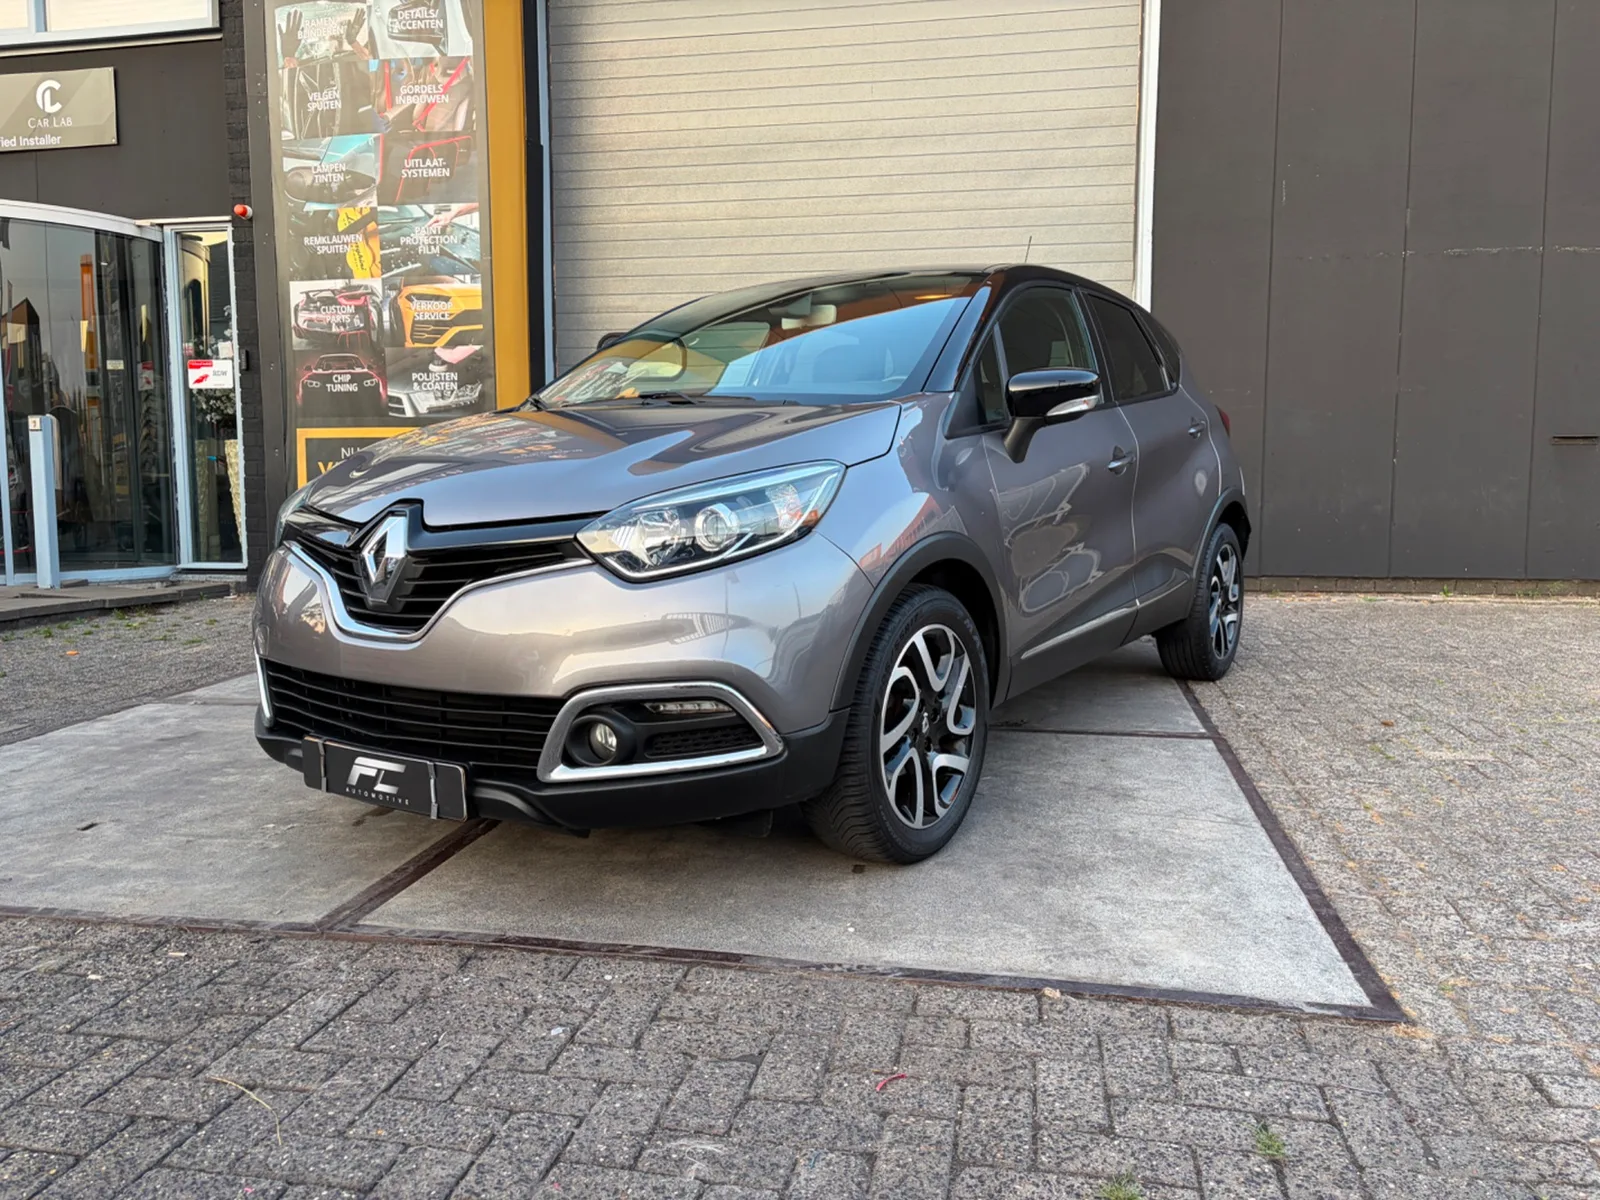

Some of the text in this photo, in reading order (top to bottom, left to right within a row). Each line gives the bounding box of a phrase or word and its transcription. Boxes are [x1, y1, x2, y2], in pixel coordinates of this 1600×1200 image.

[397, 8, 439, 20] DETAILS/
[396, 19, 444, 30] ACCENTEN
[297, 25, 344, 39] BLINDEREN
[400, 84, 443, 95] GORDELS
[307, 91, 340, 102] VELGEN
[395, 94, 449, 105] INBOUWEN
[307, 100, 342, 112] SPUITEN
[28, 117, 73, 128] CAR LAB
[0, 134, 62, 147] ied Installer
[311, 163, 346, 174] LAMPEN
[404, 158, 446, 168] UITLAAT-
[314, 173, 344, 183] TINTEN
[401, 167, 450, 178] SYSTEMEN
[414, 226, 442, 236] PAINT
[304, 234, 363, 246] REMKLAUWEN
[400, 235, 458, 246] PROTECTION
[316, 244, 350, 255] SPUITEN
[418, 245, 440, 255] FILM
[320, 305, 355, 315] CUSTOM
[410, 301, 453, 311] VERKOOP
[326, 314, 351, 324] PARTS
[414, 311, 450, 321] SERVICE
[332, 374, 352, 383] CHIP
[412, 372, 458, 382] POLIJSTEN
[326, 382, 358, 393] TUNING
[413, 381, 458, 391] & COATEN
[346, 787, 410, 806] AUTOMOTIVE
